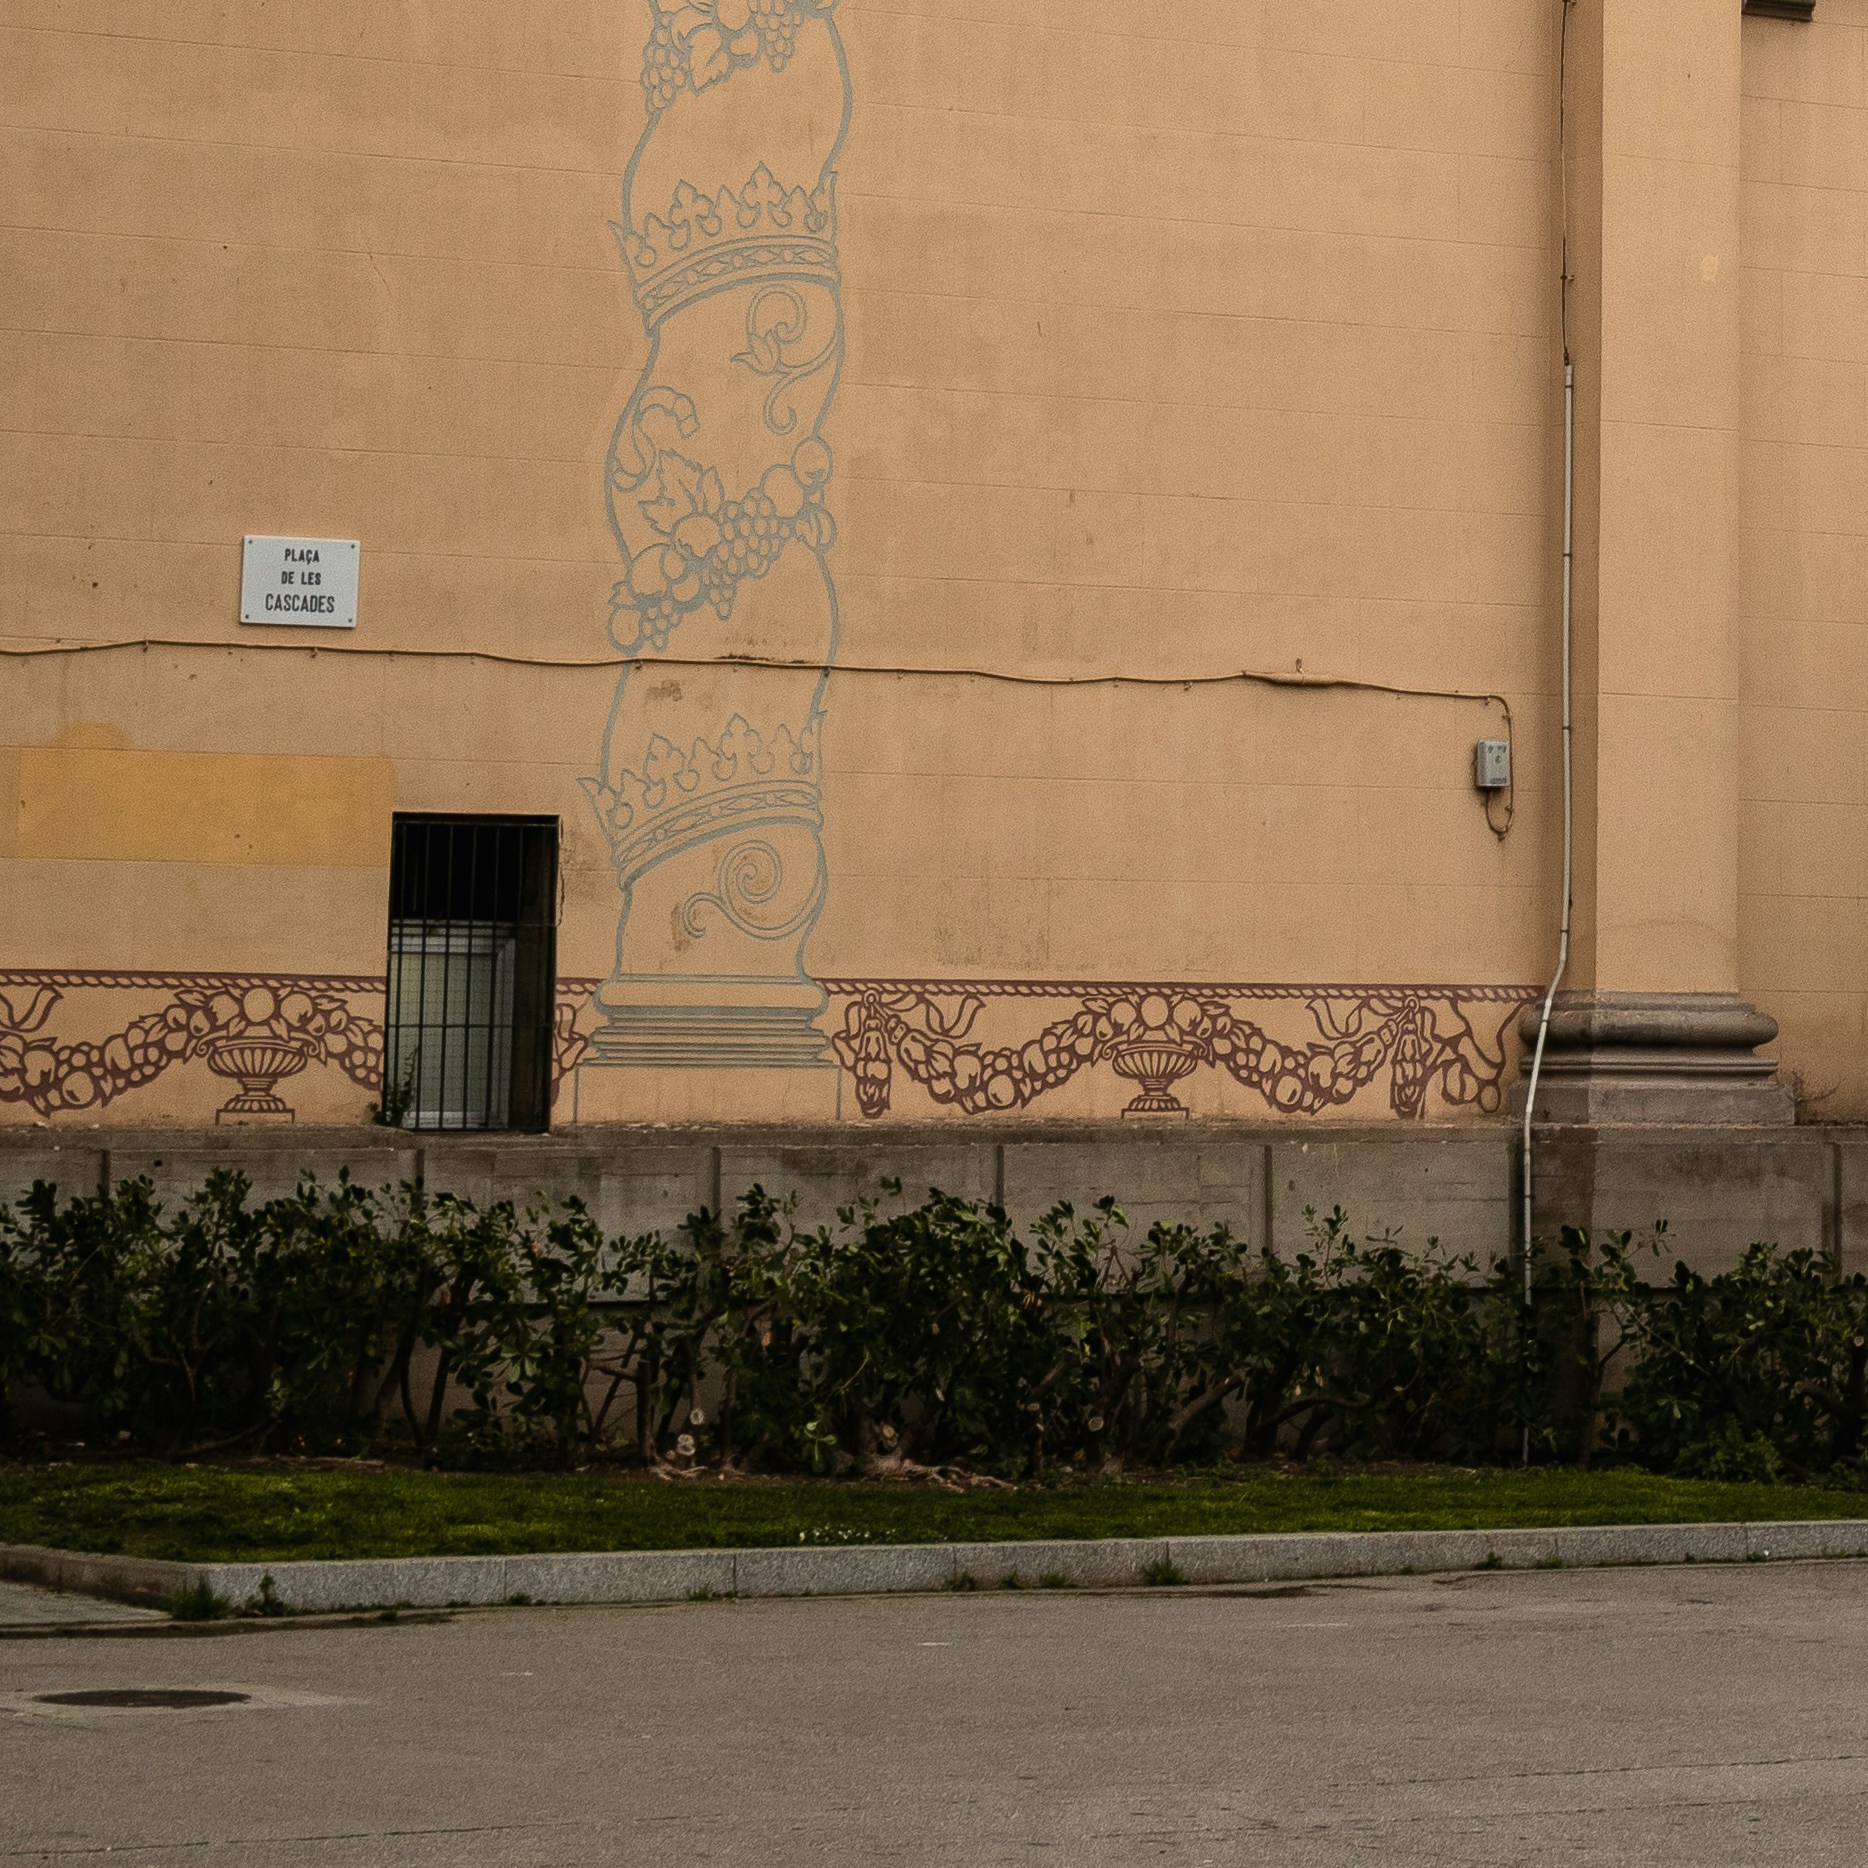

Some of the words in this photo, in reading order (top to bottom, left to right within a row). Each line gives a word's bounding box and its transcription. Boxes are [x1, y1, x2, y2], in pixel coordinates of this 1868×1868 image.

[284, 548, 320, 565] PLAÇA
[281, 571, 295, 585] DE
[301, 572, 322, 586] LES
[265, 593, 335, 614] CASCADES
